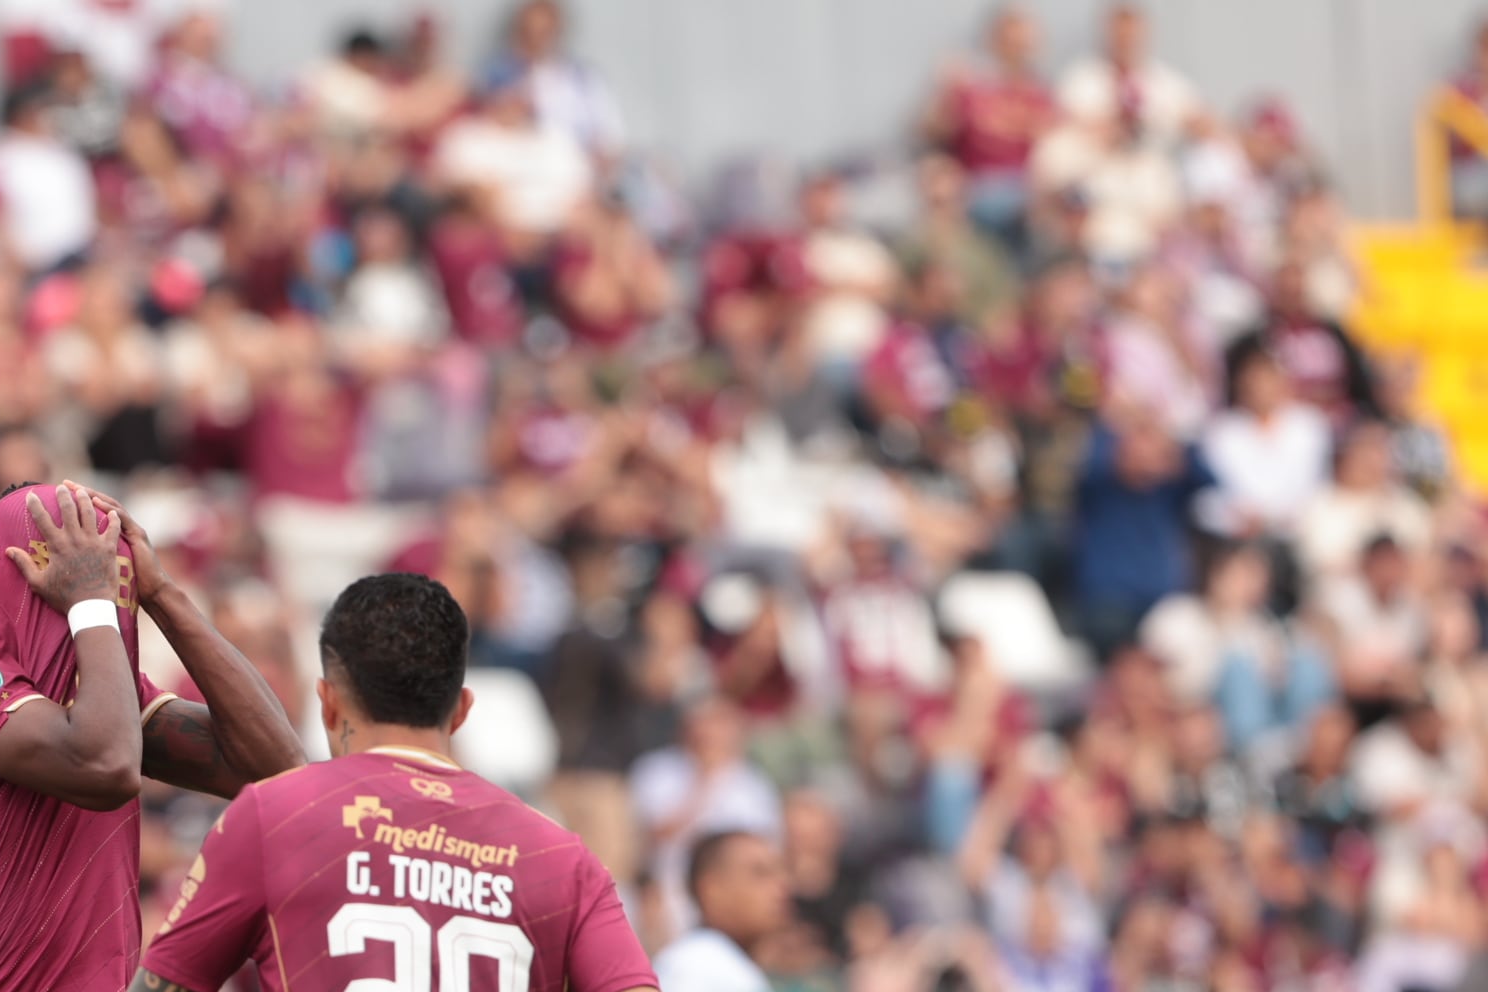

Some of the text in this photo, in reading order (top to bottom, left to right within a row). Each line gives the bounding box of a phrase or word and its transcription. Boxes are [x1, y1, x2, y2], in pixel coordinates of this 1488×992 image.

[374, 823, 520, 867] medismart
[346, 851, 514, 918] G. TORRES
